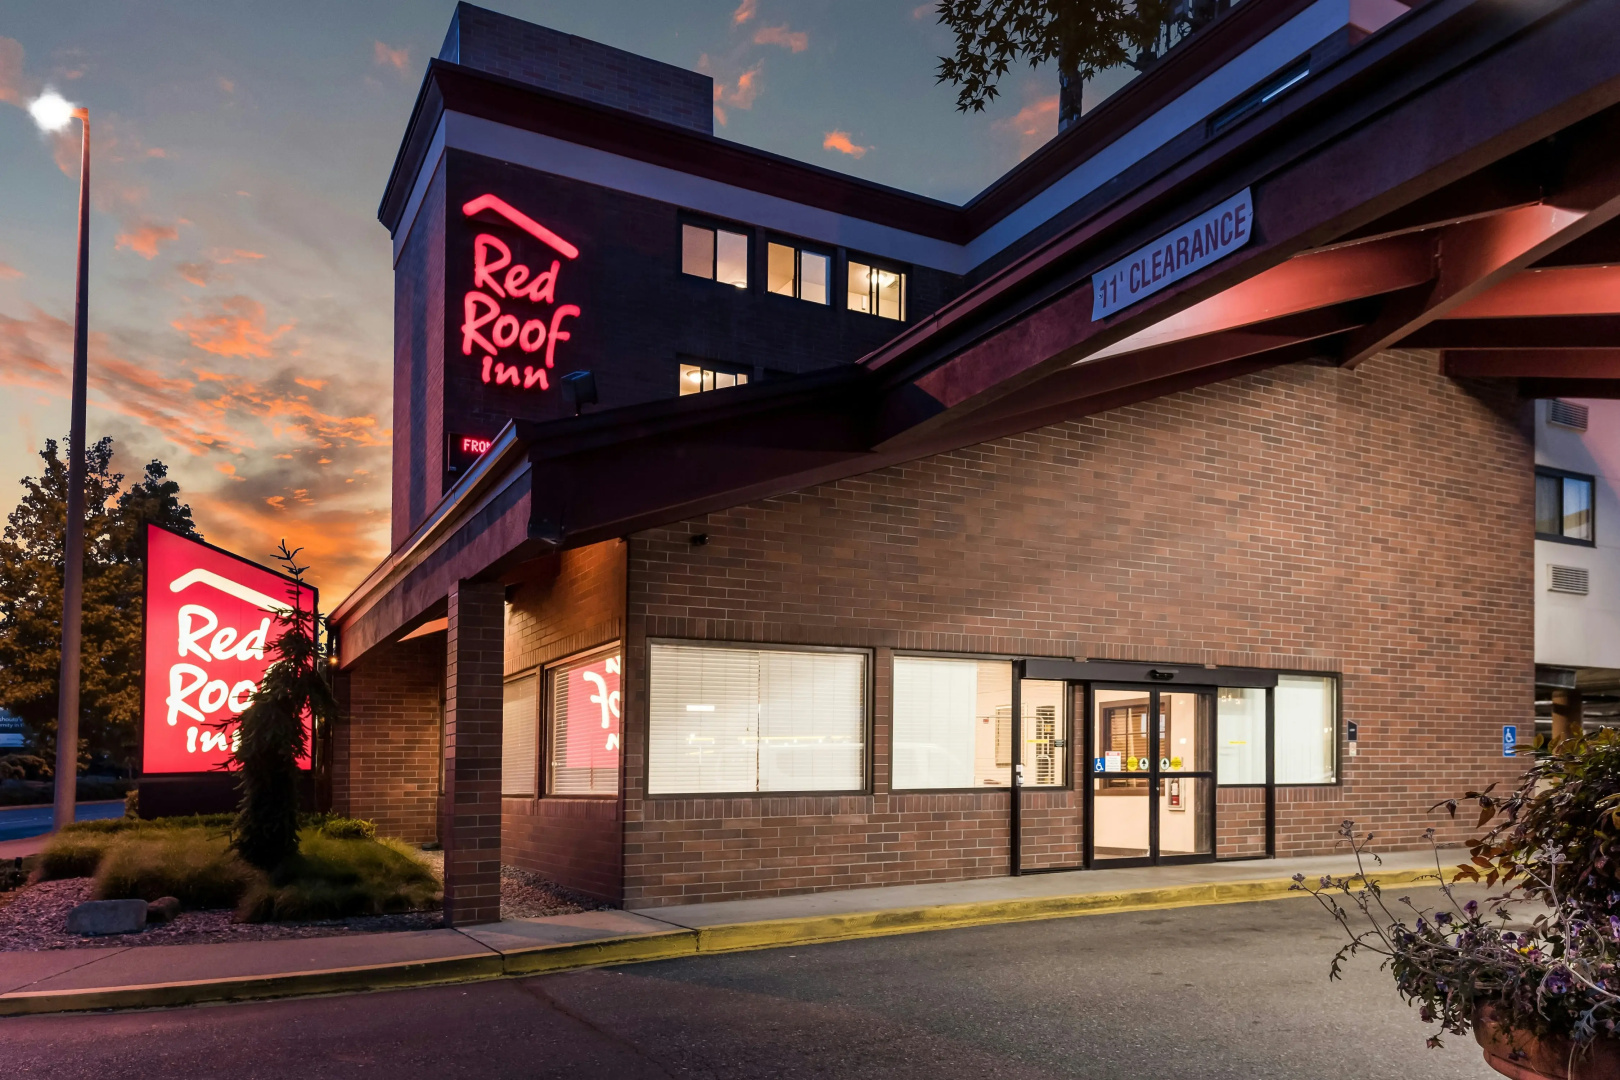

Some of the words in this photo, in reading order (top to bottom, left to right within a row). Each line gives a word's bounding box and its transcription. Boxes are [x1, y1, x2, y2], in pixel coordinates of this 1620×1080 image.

[474, 233, 561, 304] Red
[1100, 270, 1124, 308] 11'
[1129, 203, 1247, 294] CLEARANCE
[461, 291, 581, 369] Roof
[178, 604, 271, 662] Red
[165, 660, 296, 726] Roo
